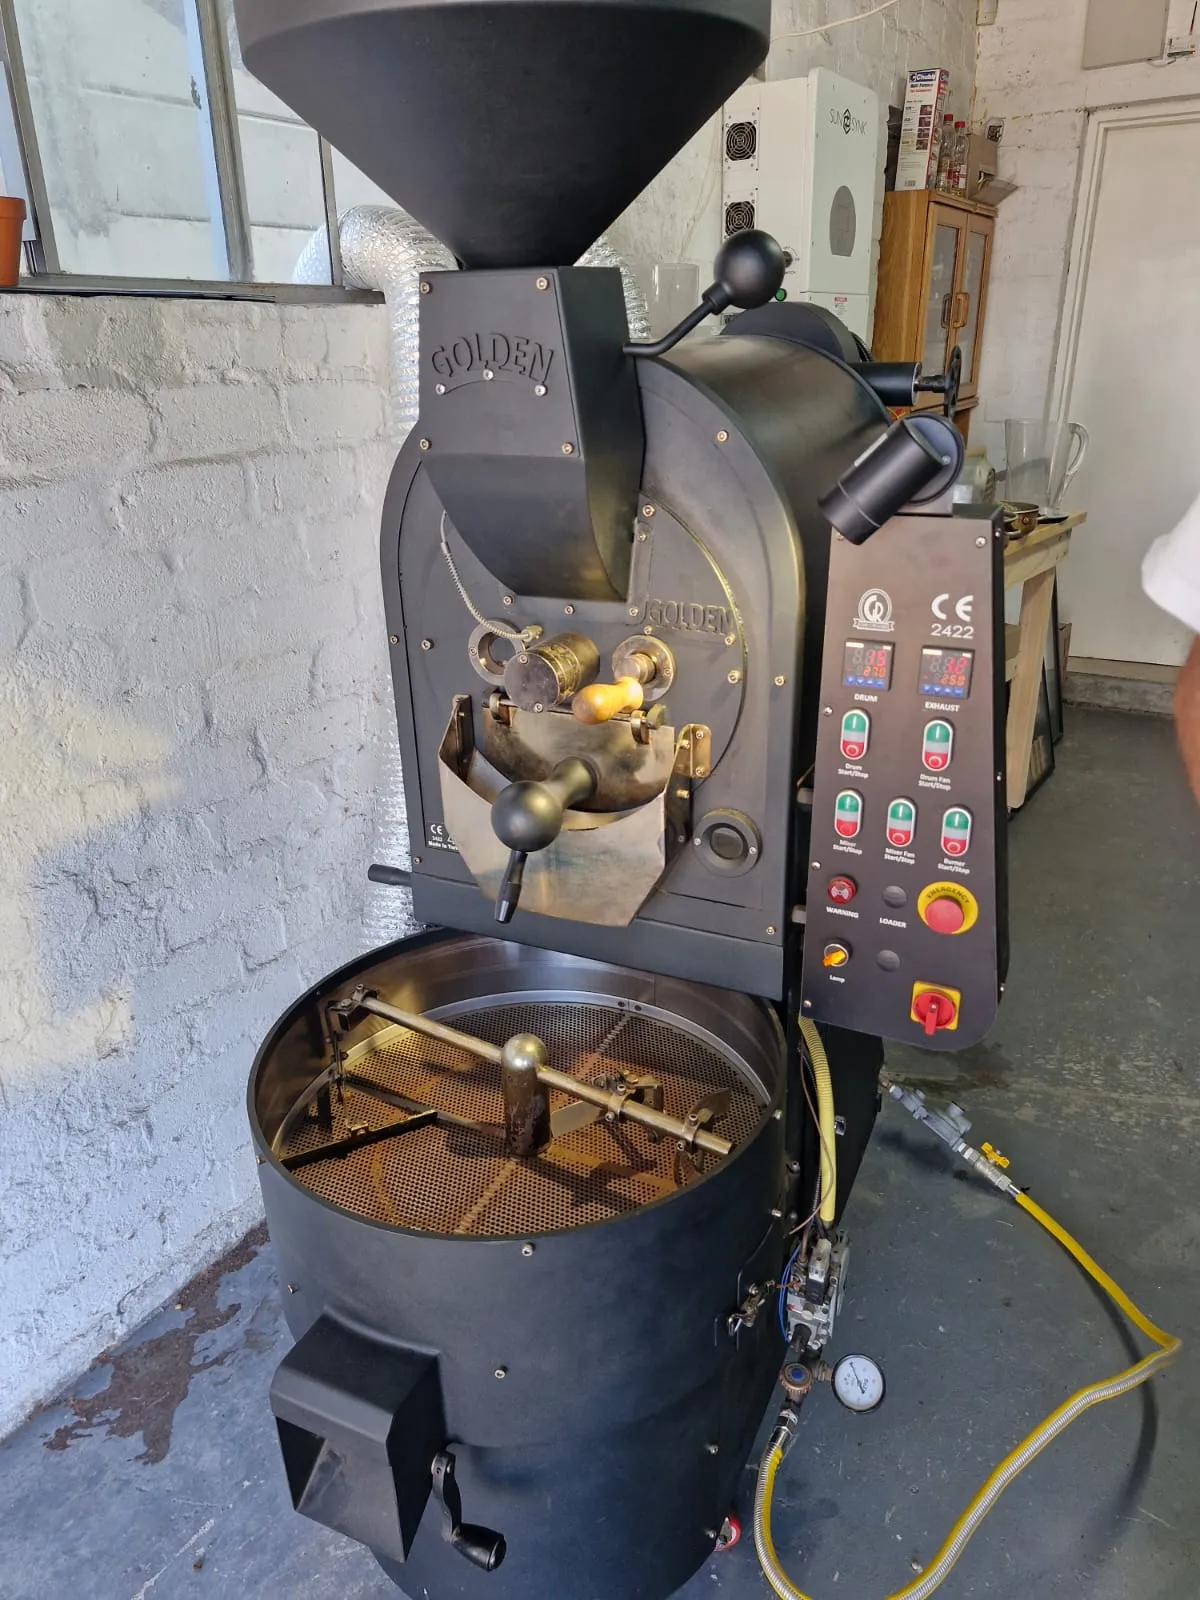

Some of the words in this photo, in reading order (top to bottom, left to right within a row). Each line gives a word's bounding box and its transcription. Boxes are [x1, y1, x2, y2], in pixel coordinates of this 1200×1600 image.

[431, 333, 554, 384] GOLDEN
[649, 599, 735, 635] GOLDEN
[930, 623, 975, 639] 2422
[854, 693, 878, 703] DRUM
[925, 701, 960, 712] EXHAUST
[845, 763, 862, 771] Drum
[838, 768, 869, 779] Start/Stop
[920, 773, 938, 782] Drum
[939, 775, 951, 783] Fan
[918, 780, 951, 791] Start/Stop
[832, 844, 862, 854] Start/Stop
[885, 848, 903, 857] Mixer
[904, 850, 915, 858] Fan
[884, 854, 915, 865] Start/Stop
[943, 857, 965, 867] Burner
[938, 863, 970, 875] Start/Stop
[927, 886, 970, 904] EMERGENCY
[826, 906, 859, 919] WARNING
[879, 917, 907, 929] LOADER
[829, 975, 845, 984] Lamp
